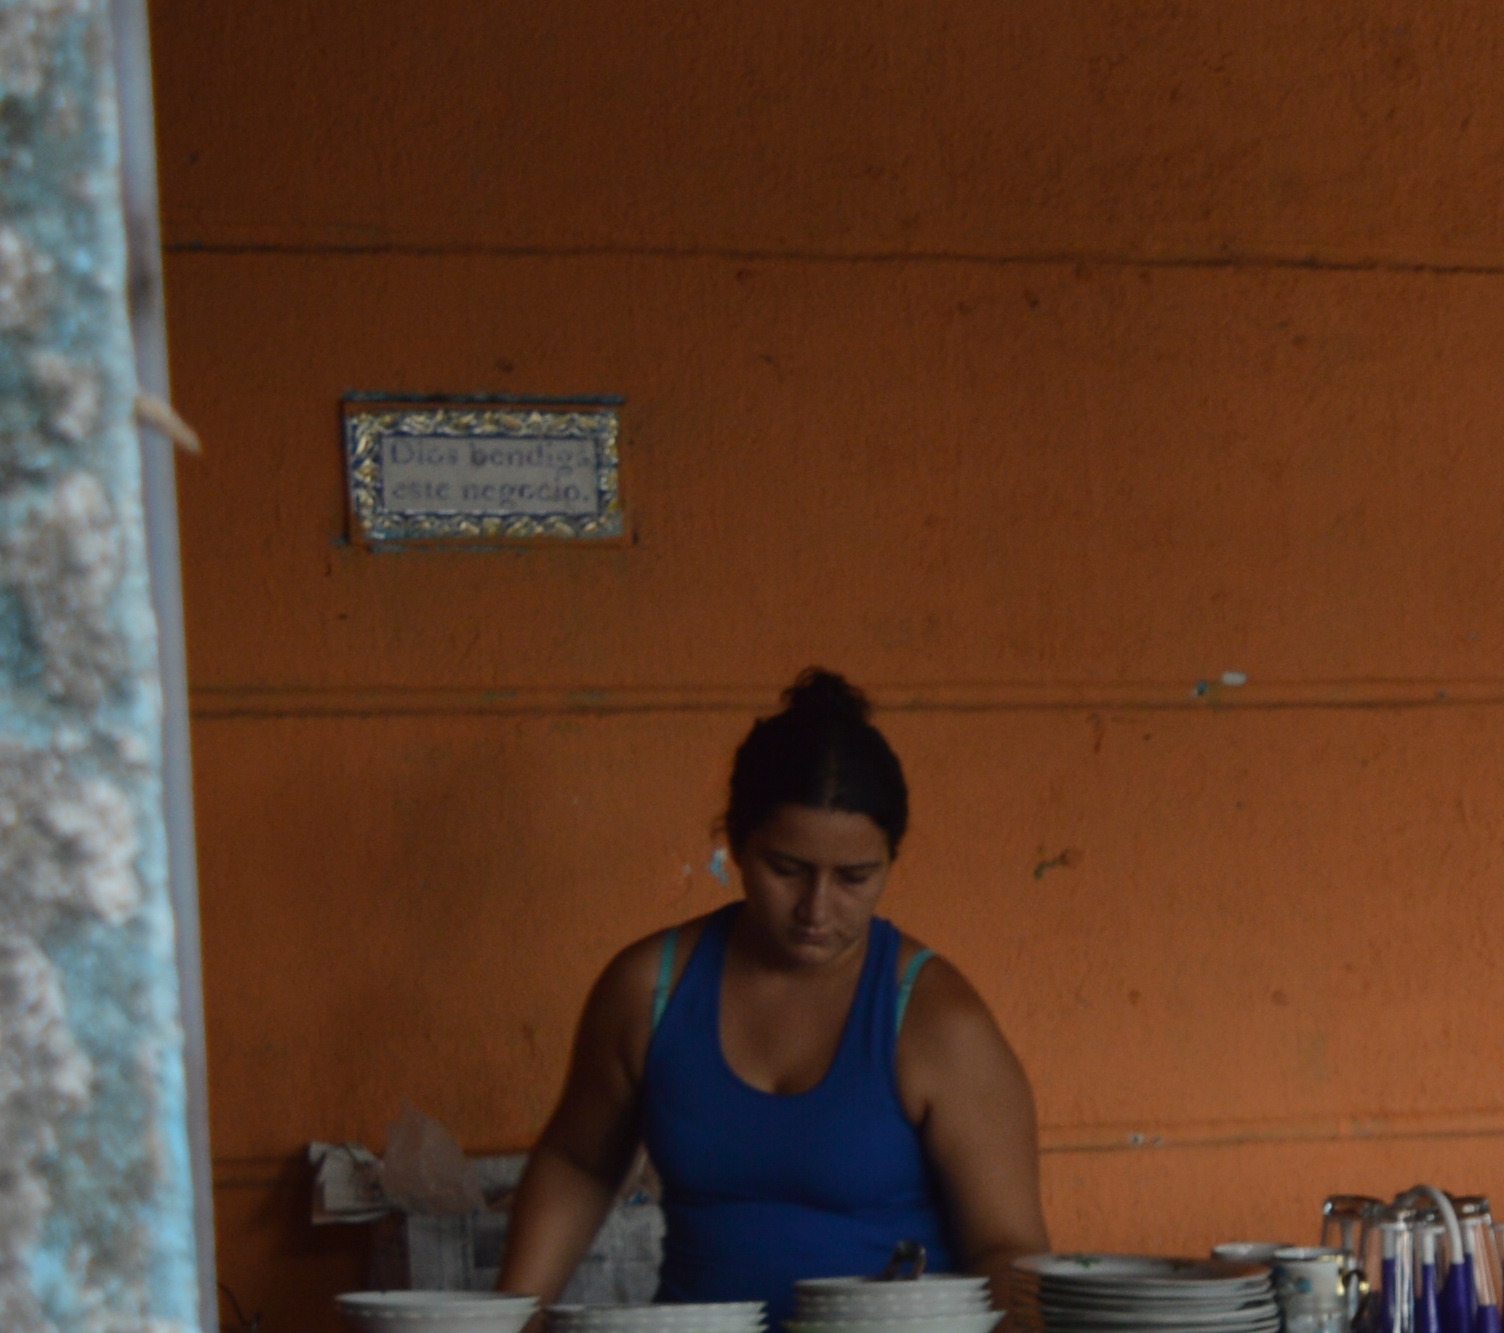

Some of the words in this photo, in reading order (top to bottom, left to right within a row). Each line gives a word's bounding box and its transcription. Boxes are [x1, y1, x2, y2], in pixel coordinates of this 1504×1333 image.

[389, 438, 459, 465] Dios
[469, 438, 592, 477] bendiga
[391, 480, 450, 501] este
